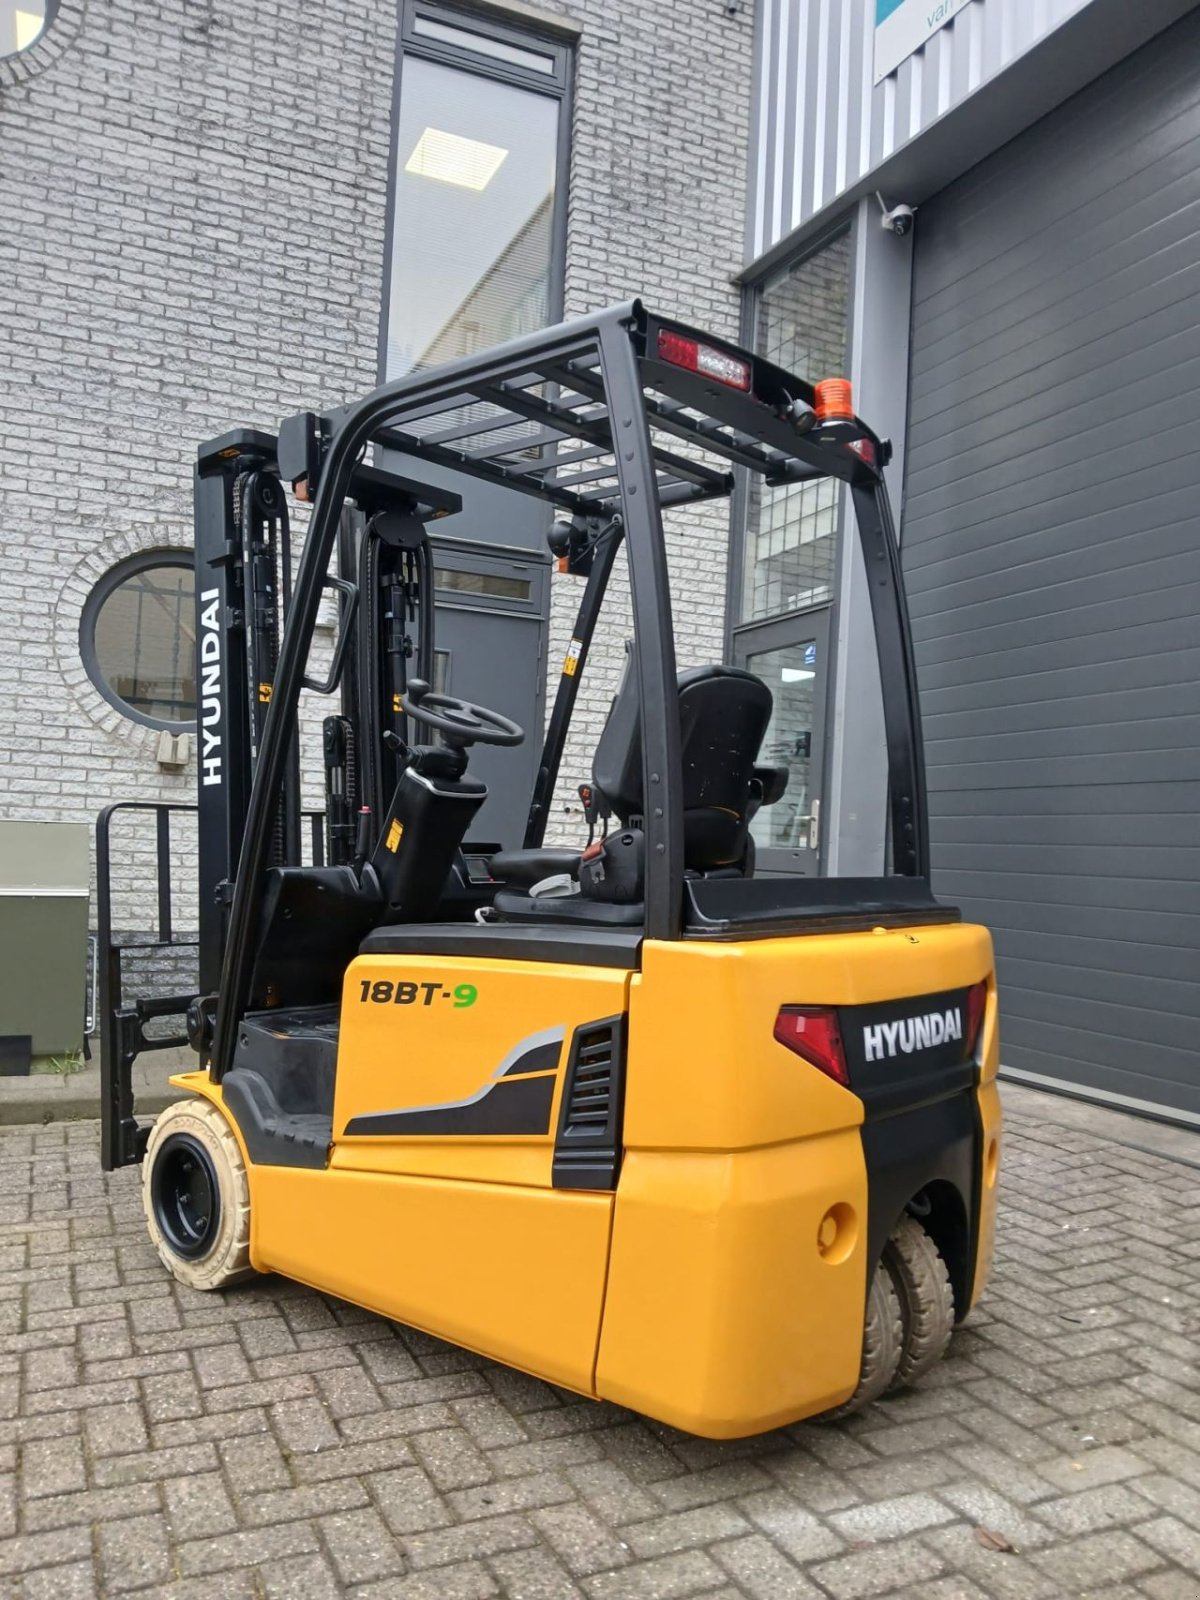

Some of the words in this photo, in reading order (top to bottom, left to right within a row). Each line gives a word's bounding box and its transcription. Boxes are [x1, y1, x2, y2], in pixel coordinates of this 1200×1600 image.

[201, 588, 221, 785] HYUNDAI
[360, 980, 478, 1008] 18BT-9
[863, 1007, 962, 1062] HYUNDAI
